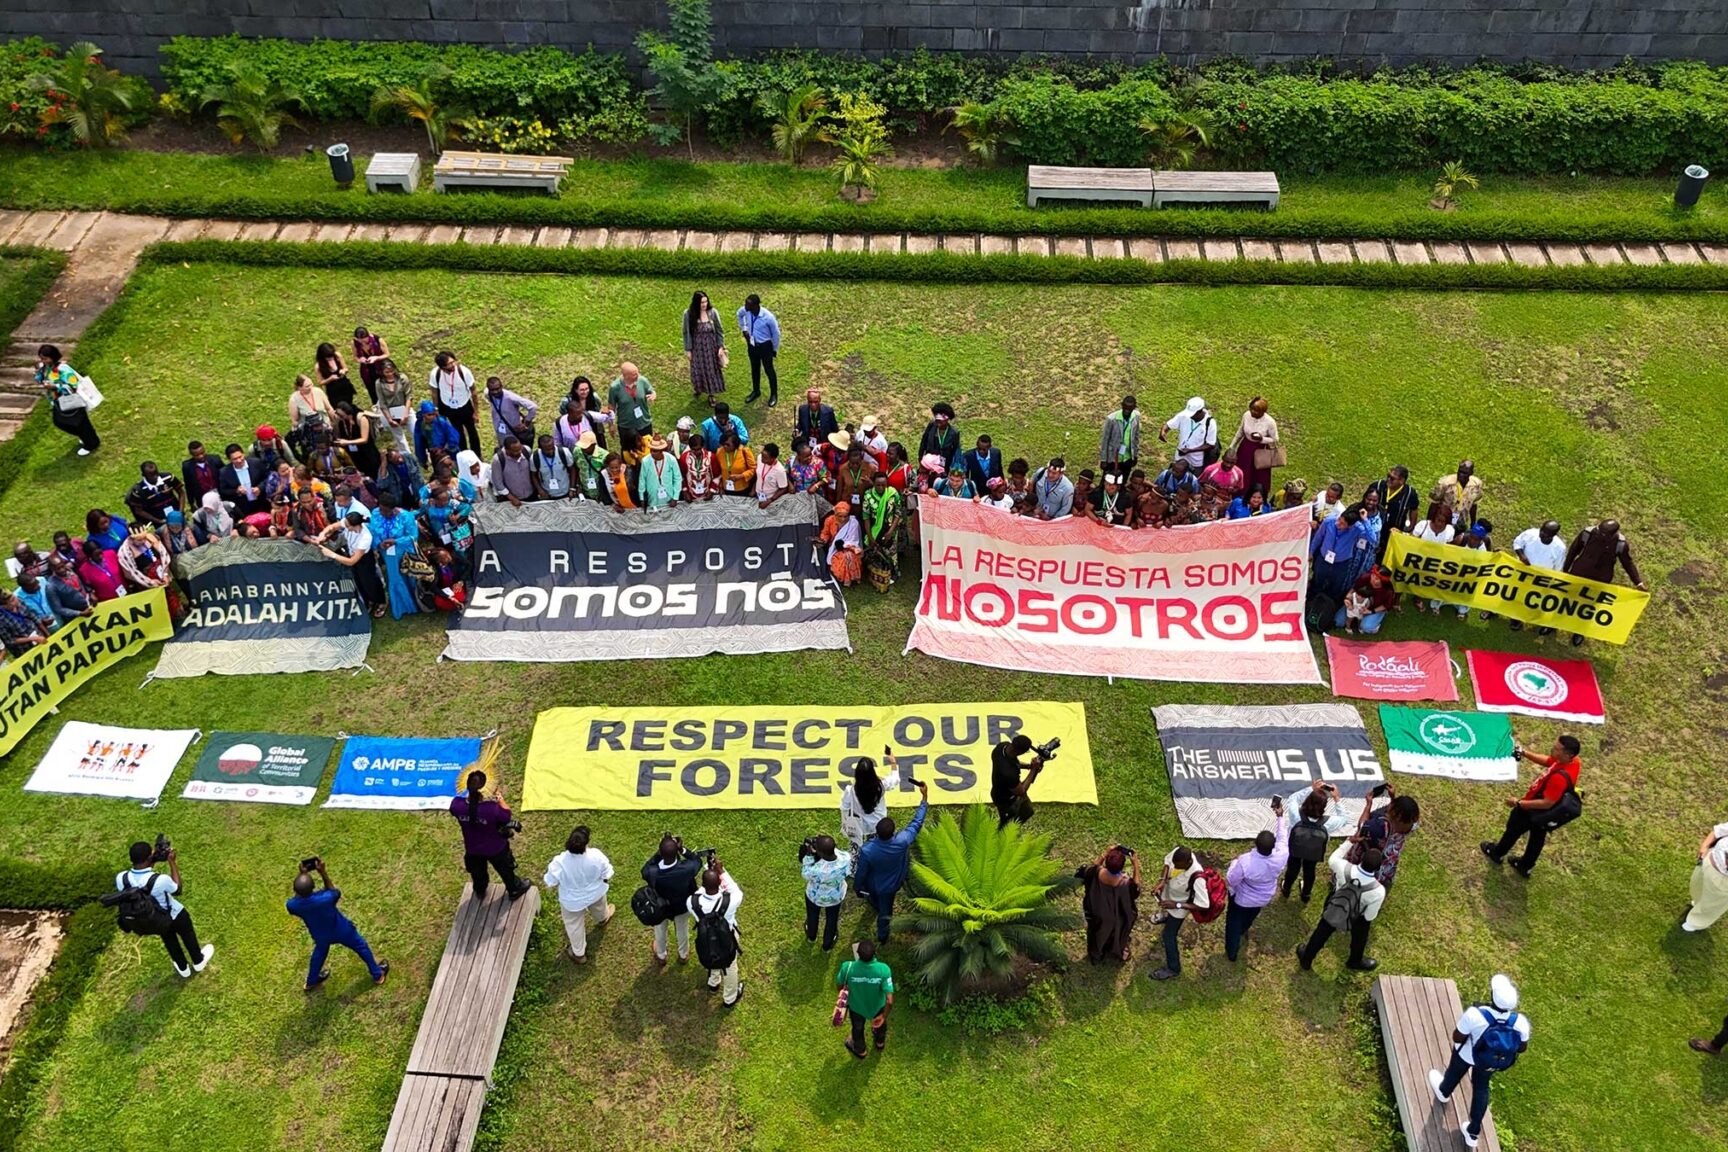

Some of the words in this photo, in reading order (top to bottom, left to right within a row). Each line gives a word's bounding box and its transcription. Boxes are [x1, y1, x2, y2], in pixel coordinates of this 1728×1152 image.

[480, 551, 501, 573] A
[550, 543, 820, 574] RESPOSTA
[928, 540, 963, 571] LA
[975, 549, 1171, 589] RESPUESTA
[1184, 557, 1302, 588] SOMOS
[191, 580, 340, 605] AWABANNYA
[1403, 552, 1571, 593] RESPECTEZ
[1578, 586, 1617, 606] LE
[919, 572, 1304, 642] NOSOTROS
[1394, 568, 1477, 595] BASSIN
[1483, 581, 1518, 601] DU
[1524, 593, 1614, 626] CONGO
[181, 602, 298, 628] ADALAH
[306, 598, 363, 622] KITA
[55, 628, 146, 685] PAPUA
[586, 719, 872, 751] RESPECT
[893, 715, 1024, 748] OUR
[264, 755, 309, 765] Alliance
[268, 746, 306, 757] Global
[370, 757, 417, 772] AMPB
[1167, 746, 1211, 765] THE
[1266, 749, 1313, 780] IS
[1315, 749, 1385, 781] US
[1173, 763, 1270, 780] ANSWER
